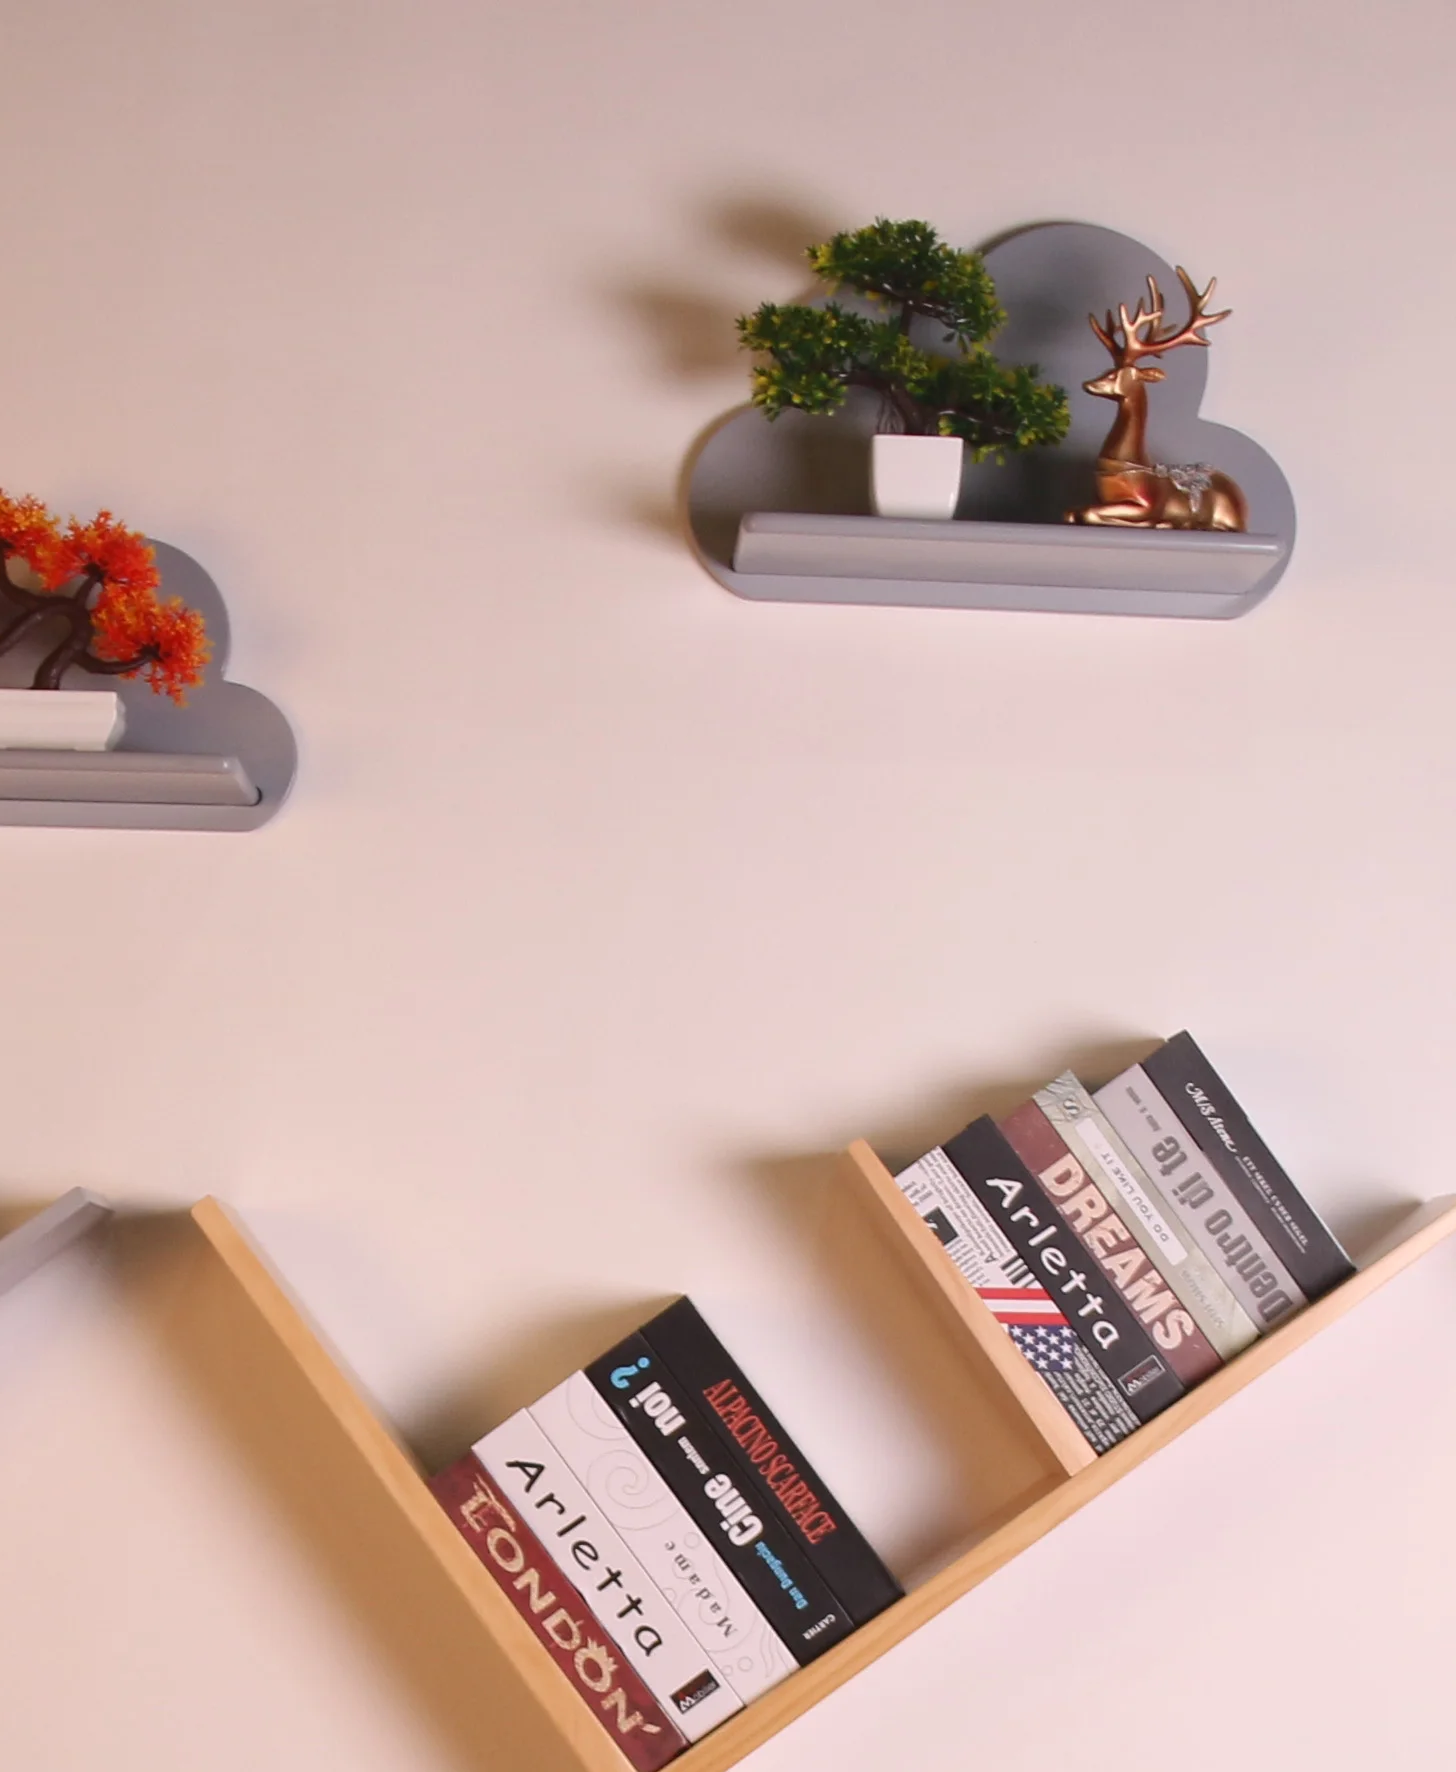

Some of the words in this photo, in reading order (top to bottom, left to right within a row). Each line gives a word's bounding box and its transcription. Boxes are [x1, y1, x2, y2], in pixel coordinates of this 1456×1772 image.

[1100, 1151, 1114, 1166] IT
[1110, 1165, 1135, 1196] LIKE
[1147, 1133, 1191, 1177] te
[1131, 1194, 1155, 1223] YOU
[1170, 1170, 1215, 1214] di
[1038, 1153, 1193, 1351] DREAMS
[1152, 1223, 1170, 1244] DO
[986, 1175, 1121, 1351] Arletta
[1196, 1205, 1295, 1325] Dentro
[628, 1379, 687, 1443] noi
[695, 1469, 766, 1551] Cine
[762, 1456, 838, 1544] SCARFACE
[506, 1459, 664, 1657] Arletta
[664, 1540, 738, 1638] Madame
[785, 1585, 810, 1611] Dan
[802, 1613, 837, 1640] CARTIER
